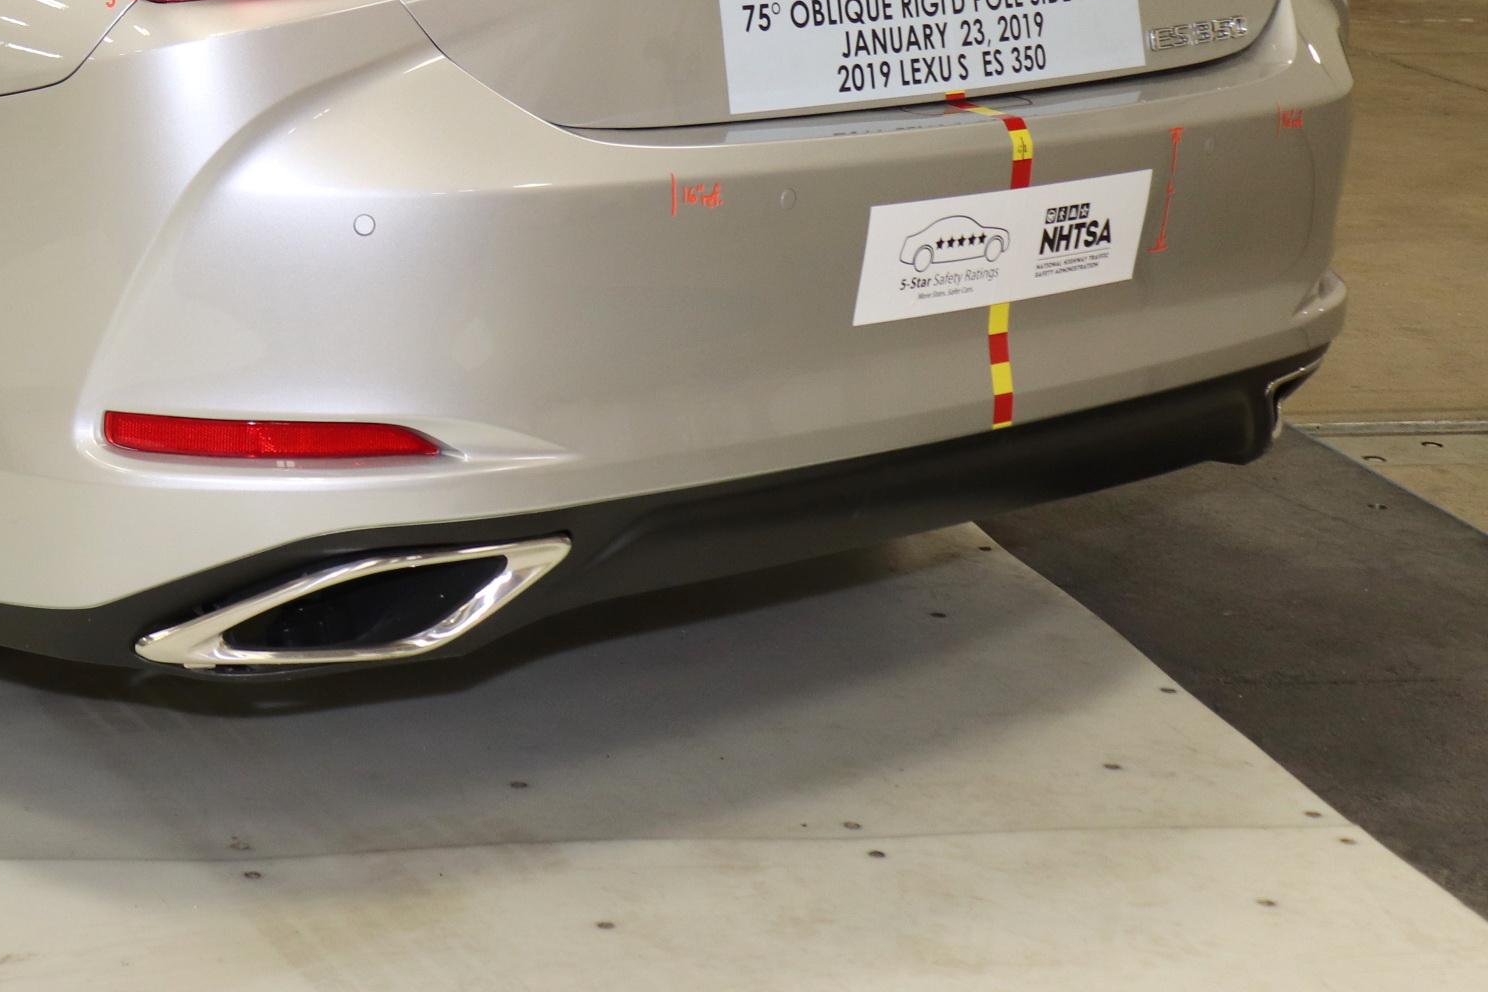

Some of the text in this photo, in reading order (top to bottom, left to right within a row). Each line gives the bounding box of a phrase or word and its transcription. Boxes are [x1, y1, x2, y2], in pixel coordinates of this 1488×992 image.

[742, 2, 781, 33] 75°
[842, 11, 1044, 59] JANUARY 23, 2019
[837, 43, 1046, 93] 2019 LEXUS ES 350
[1038, 217, 1112, 255] NHTSA
[899, 268, 999, 291] 5-Star Safety Ratings
[1034, 269, 1054, 278] SAFETY
